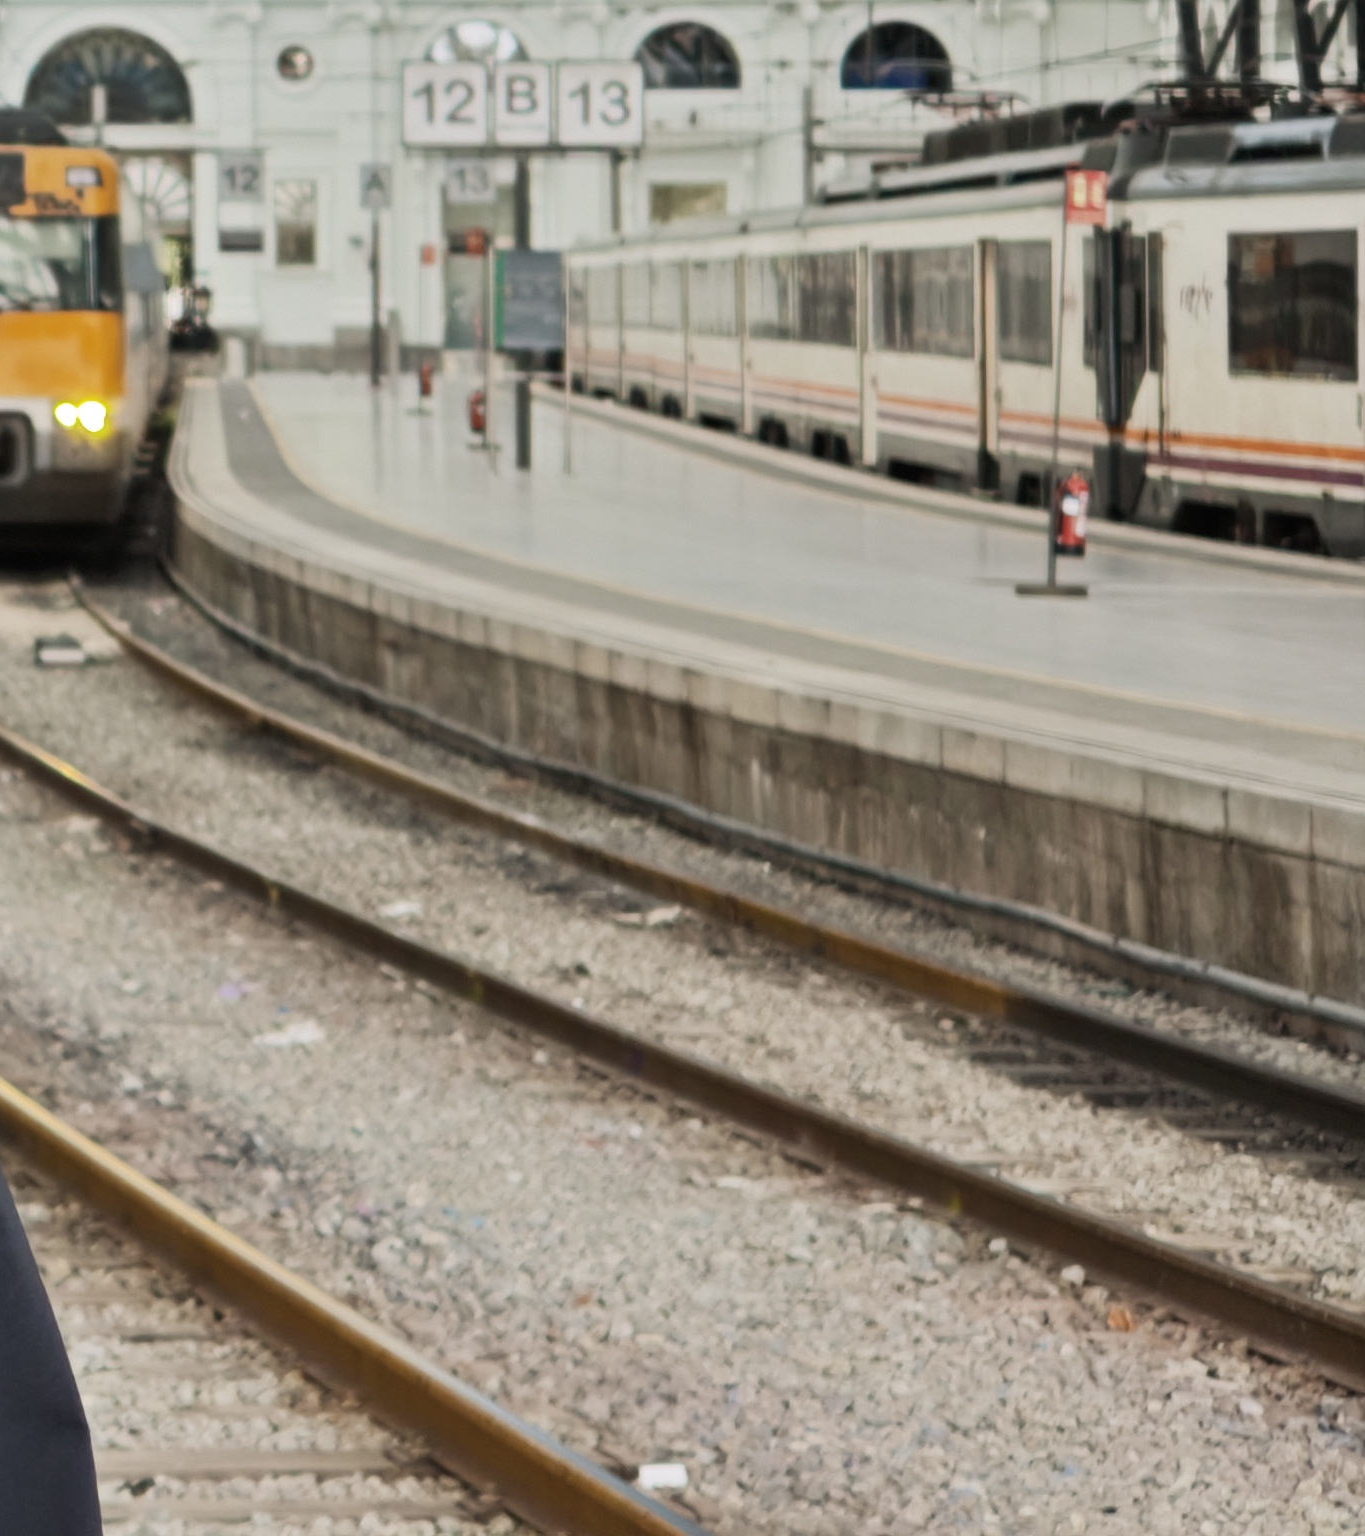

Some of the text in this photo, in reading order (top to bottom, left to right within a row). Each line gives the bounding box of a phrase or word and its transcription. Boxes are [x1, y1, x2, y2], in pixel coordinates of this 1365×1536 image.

[412, 74, 631, 126] 12 B 13
[223, 167, 260, 194] 12
[367, 171, 386, 192] A
[453, 167, 489, 194] 13
